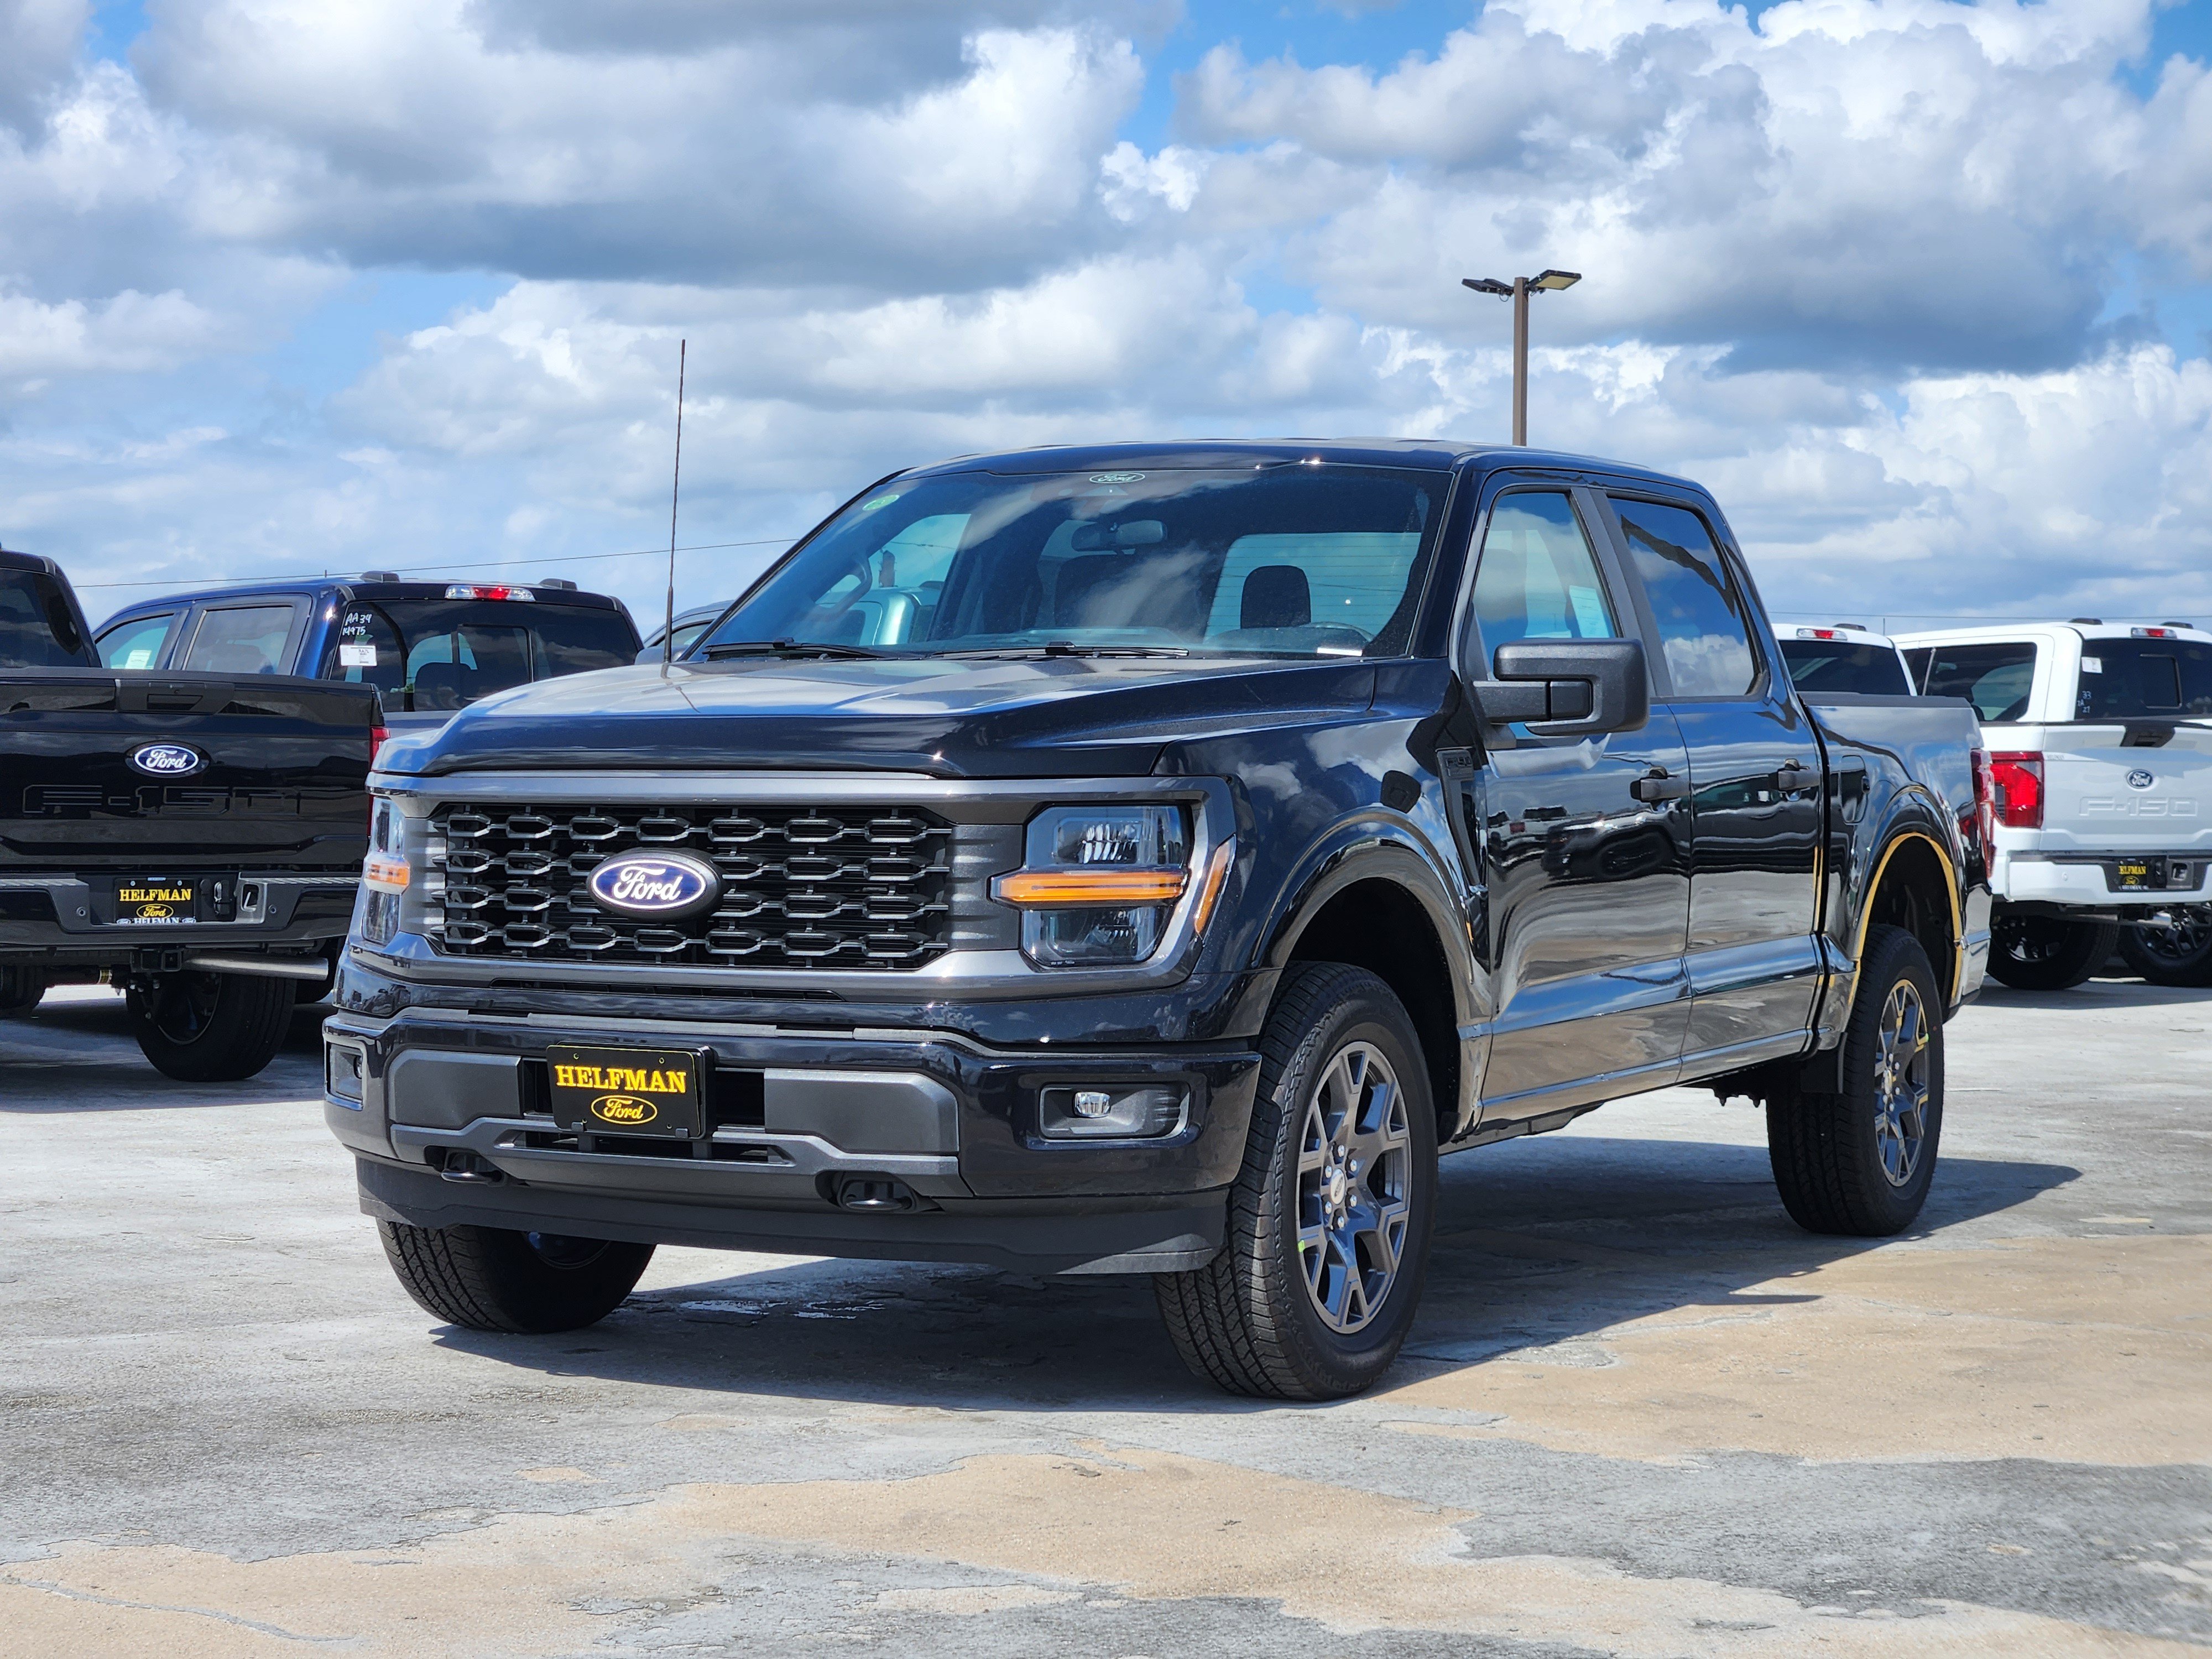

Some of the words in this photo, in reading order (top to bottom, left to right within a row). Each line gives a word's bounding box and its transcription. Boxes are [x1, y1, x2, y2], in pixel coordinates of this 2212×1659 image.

[146, 749, 188, 768] Ford
[2132, 772, 2151, 785] Ford
[23, 785, 300, 816] F-150
[2079, 796, 2198, 816] F-150
[613, 866, 684, 900] Ford
[119, 889, 192, 901] HELFMAN
[143, 905, 166, 917] Ford
[555, 1065, 687, 1093] HELFMAN
[604, 1098, 644, 1119] Ford
